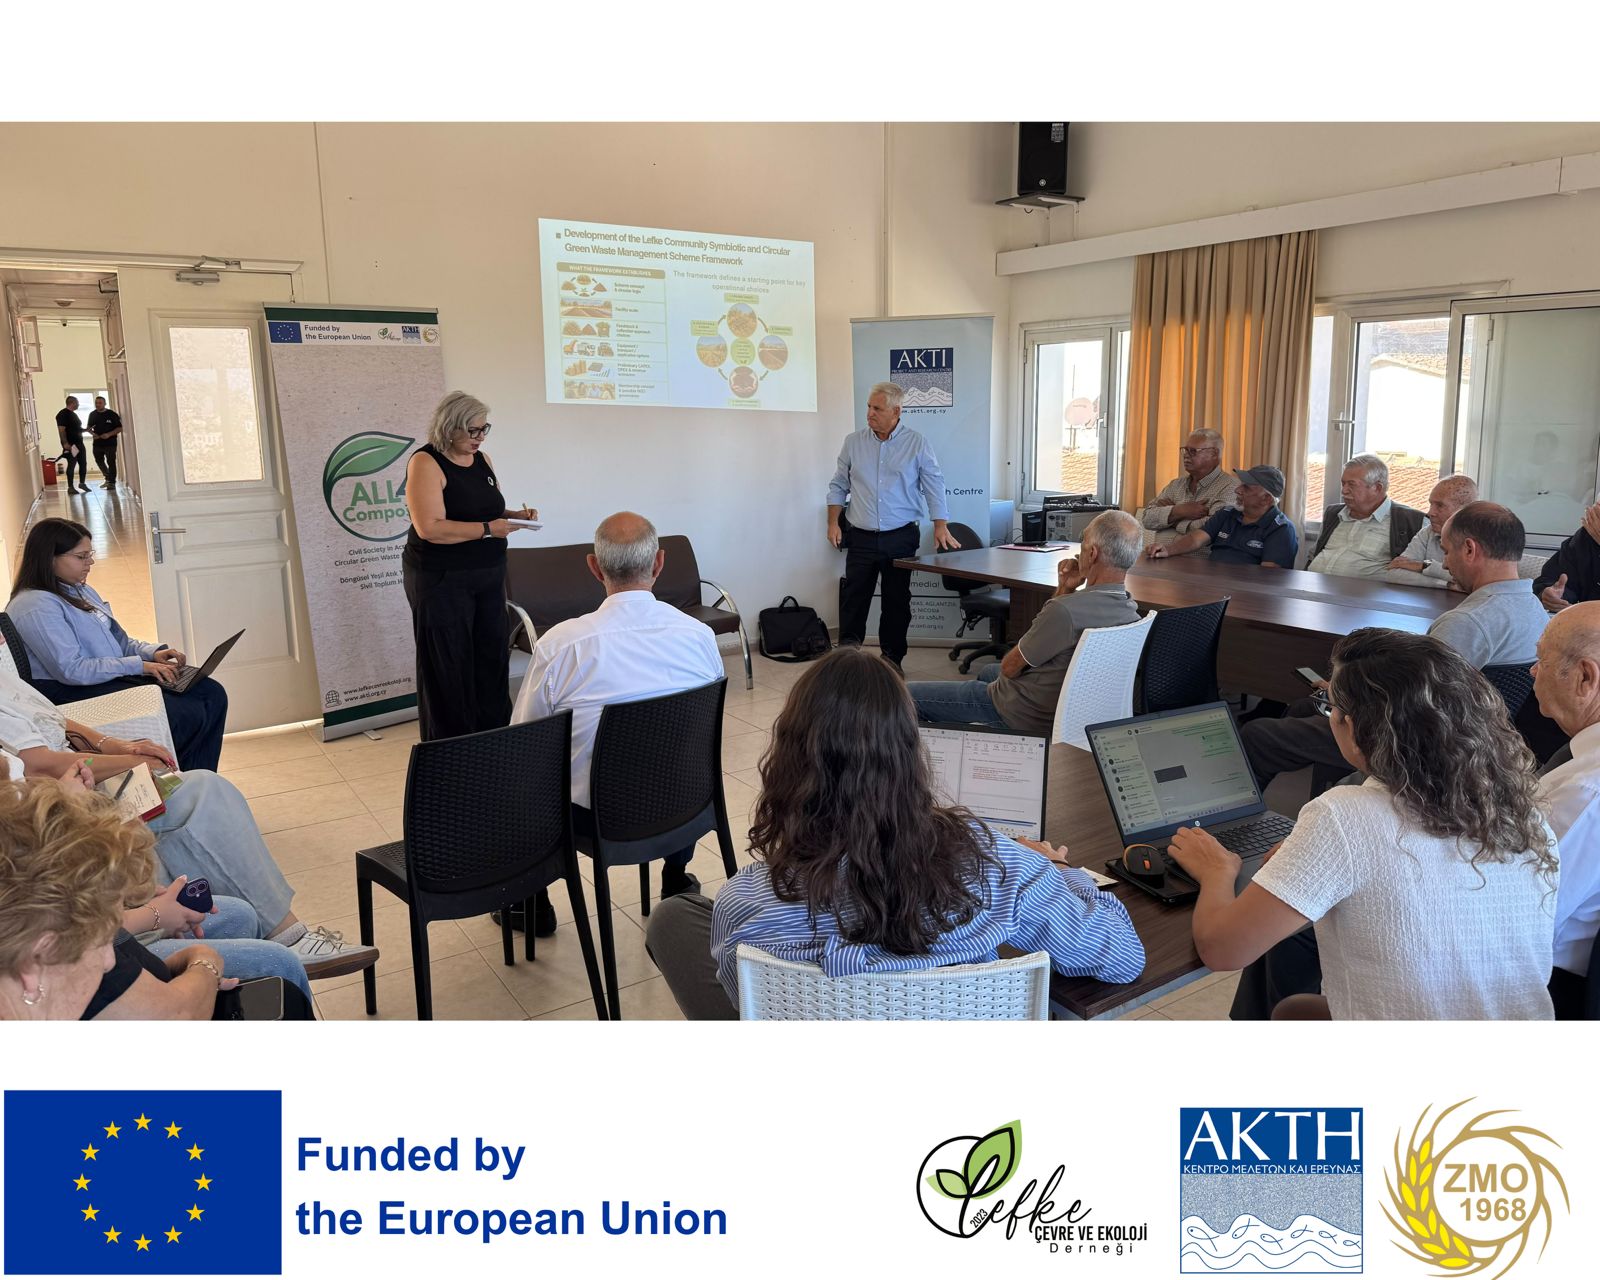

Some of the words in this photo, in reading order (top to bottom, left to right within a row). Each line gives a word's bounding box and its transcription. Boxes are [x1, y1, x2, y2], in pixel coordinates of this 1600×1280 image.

[564, 228, 617, 242] Development
[628, 235, 640, 243] the
[642, 236, 663, 246] Lefke
[664, 238, 708, 250] Community
[710, 241, 746, 252] Symbiotic
[747, 245, 761, 253] and
[763, 246, 790, 256] Circular
[565, 243, 590, 252] Green
[591, 245, 616, 255] Waste
[618, 248, 668, 259] Management
[670, 252, 700, 262] Scheme
[702, 254, 743, 266] Framework
[686, 271, 717, 280] framework
[747, 276, 769, 285] starting
[771, 278, 785, 286] point
[331, 325, 340, 333] by
[897, 349, 946, 368] AKTI
[349, 548, 362, 556] Civil
[335, 558, 359, 566] Circular
[340, 575, 370, 584] Döngüsel
[344, 690, 386, 702] www.akti.org.cy
